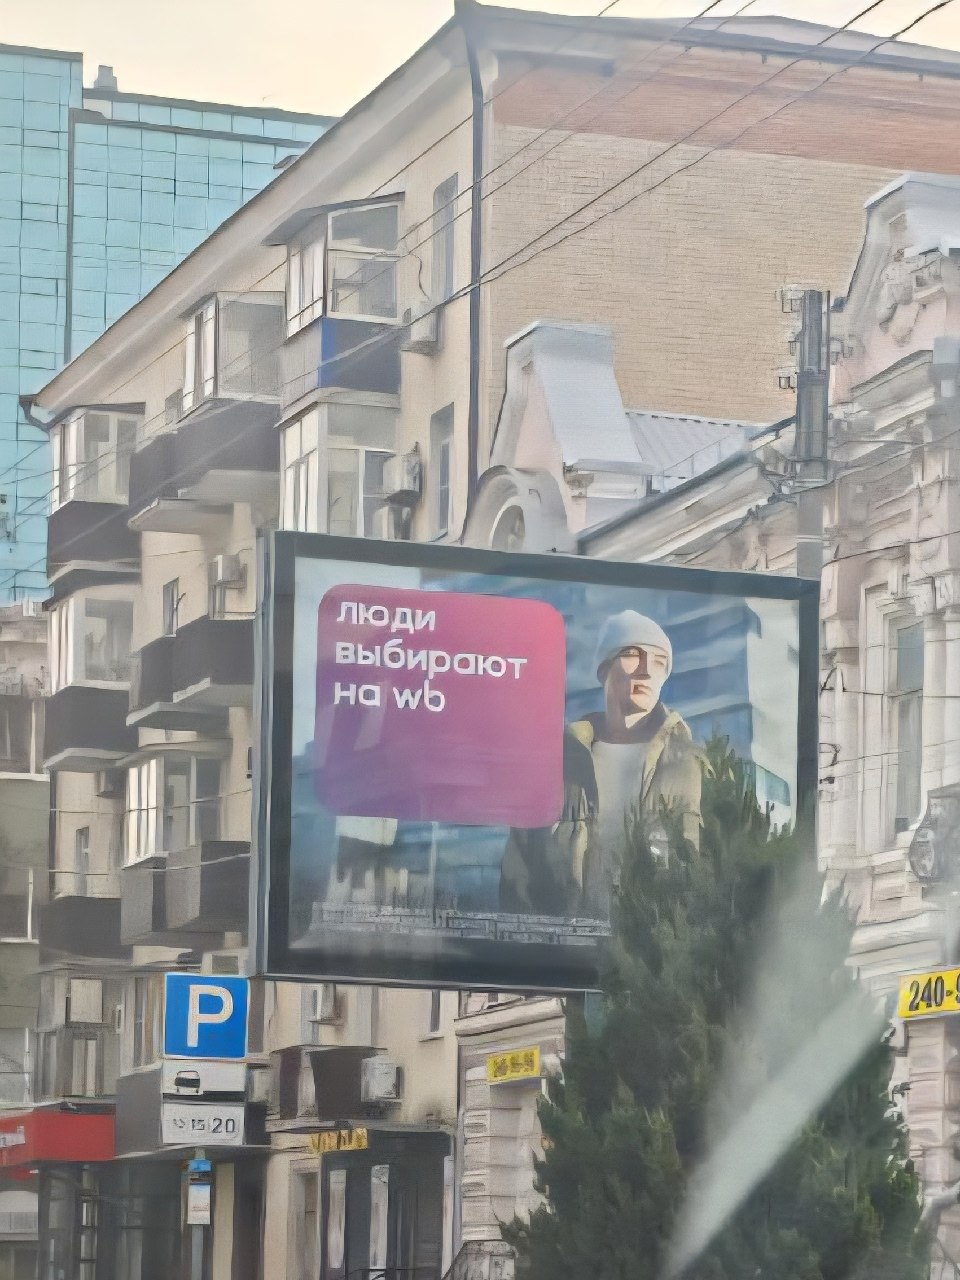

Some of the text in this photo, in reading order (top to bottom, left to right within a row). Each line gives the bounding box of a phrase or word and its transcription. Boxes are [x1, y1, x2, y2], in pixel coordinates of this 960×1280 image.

[336, 601, 436, 634] люди
[335, 638, 528, 680] выбирают
[333, 679, 446, 712] на wb
[186, 984, 234, 1048] P
[211, 1116, 236, 1134] 20
